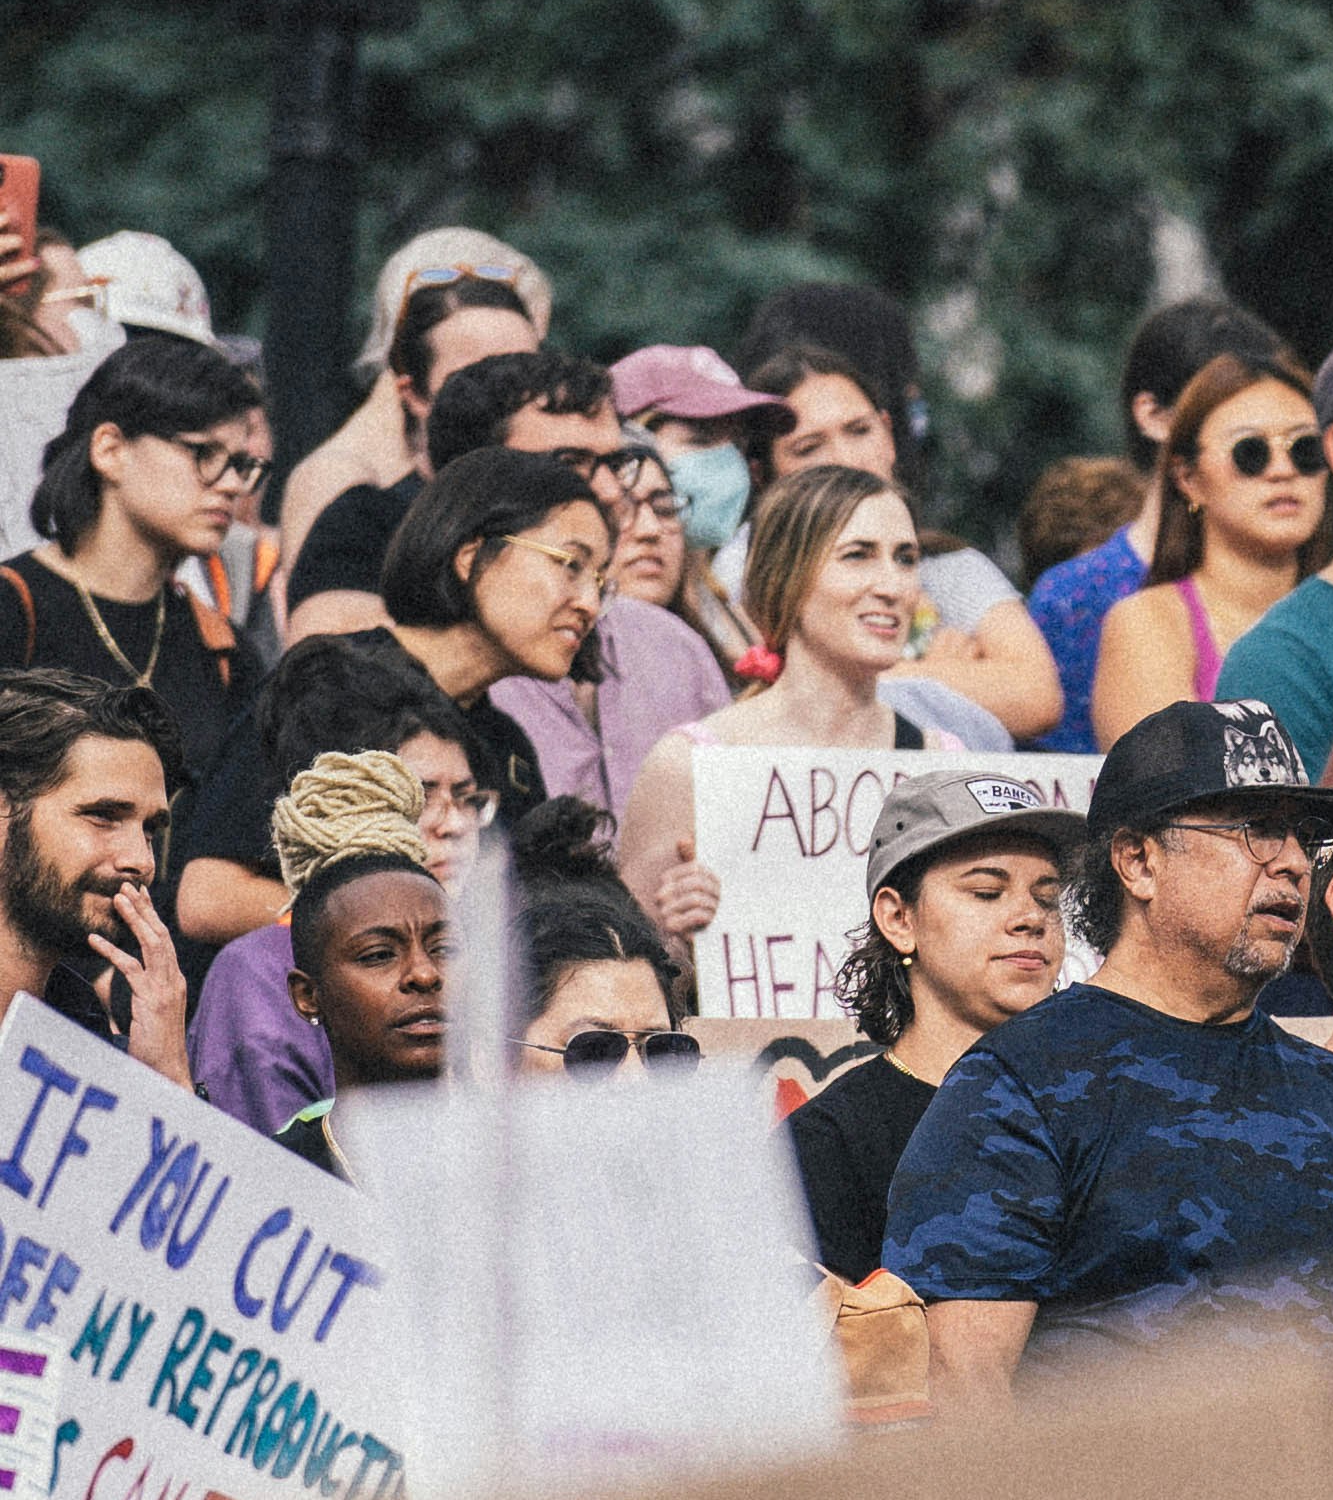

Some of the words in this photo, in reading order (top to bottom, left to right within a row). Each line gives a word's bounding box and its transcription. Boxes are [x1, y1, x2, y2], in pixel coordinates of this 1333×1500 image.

[0, 1046, 119, 1209] IF
[109, 1115, 232, 1272] YOU
[234, 1205, 382, 1344] CUT
[0, 1216, 83, 1332] FF
[70, 1289, 155, 1383] MY
